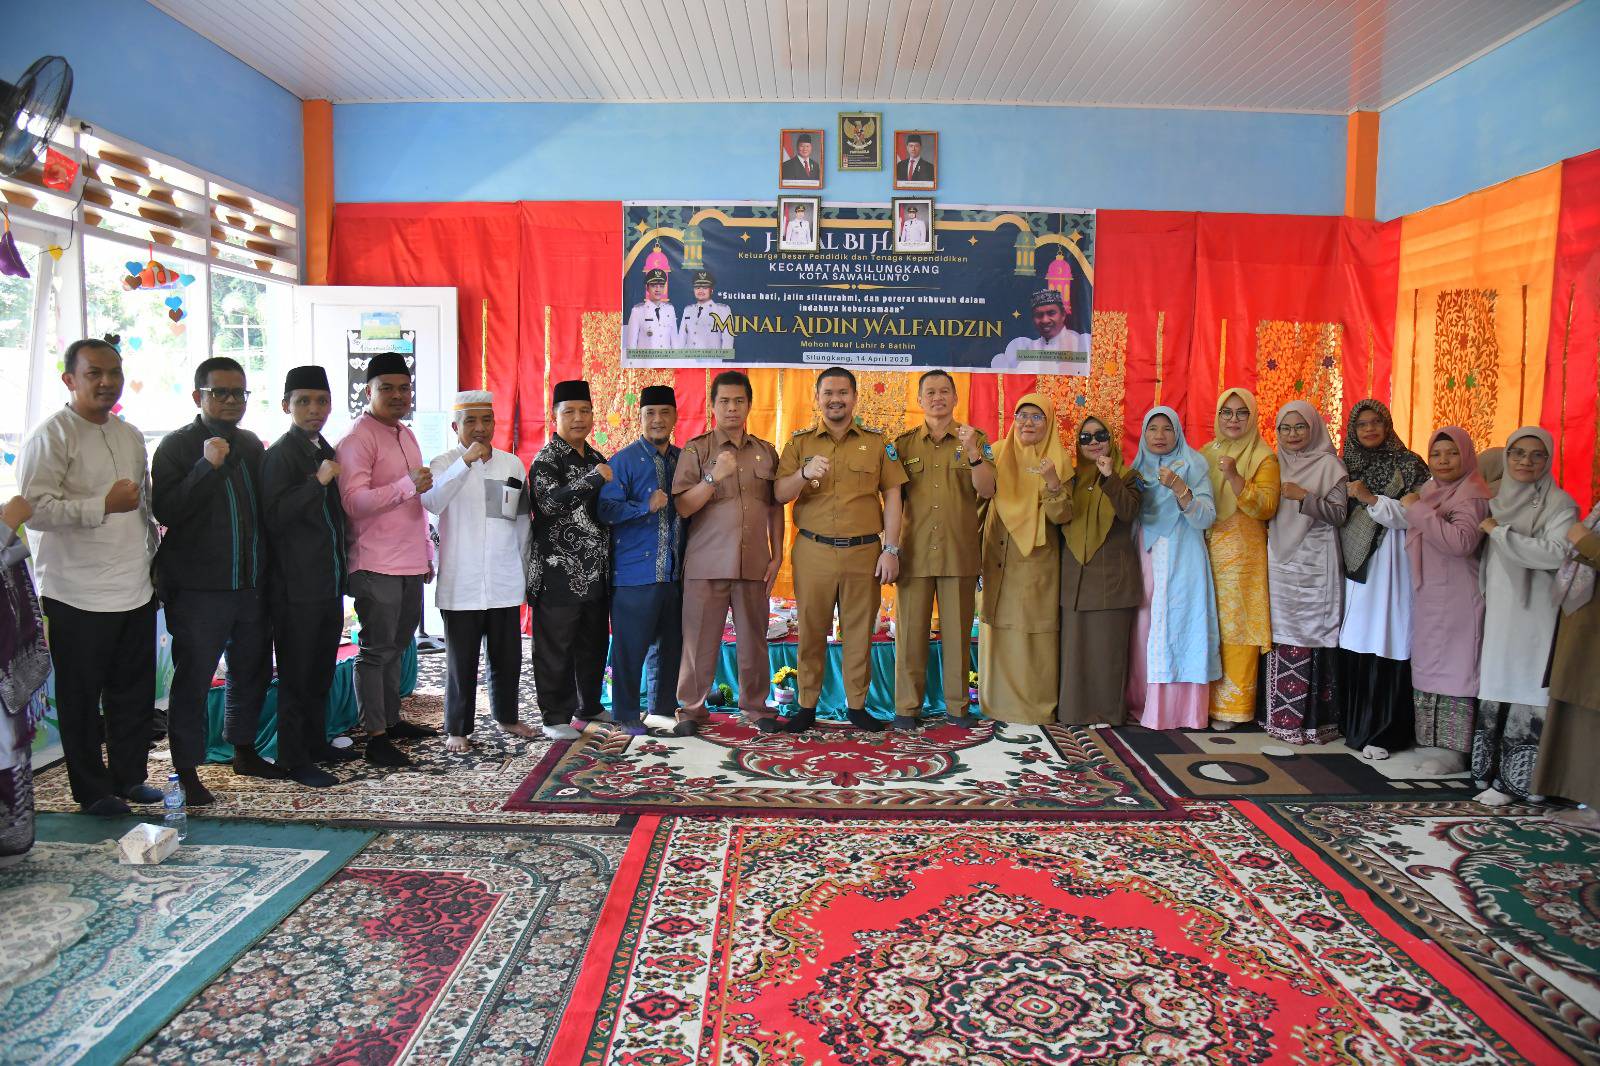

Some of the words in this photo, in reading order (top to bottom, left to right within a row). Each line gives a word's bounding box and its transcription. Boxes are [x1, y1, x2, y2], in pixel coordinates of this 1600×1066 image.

[843, 232, 865, 250] BI
[738, 252, 778, 260] Keluarga
[851, 253, 868, 261] dan
[871, 254, 903, 262] Tenaga
[906, 255, 968, 263] Kependidikan
[769, 262, 850, 273] KECAMATAN
[855, 263, 940, 275] SILUNGKANG
[799, 272, 829, 280] KOTA
[832, 272, 910, 282] SAWAHLUNTO
[759, 292, 781, 302] hati,
[783, 292, 804, 302] jalin
[806, 293, 861, 302] silaturahmi,
[864, 294, 880, 302] dan
[882, 294, 915, 303] pererat
[917, 295, 957, 304] ukhuwah
[959, 295, 986, 304] dalam
[799, 303, 839, 313] indahnya
[709, 312, 788, 337] MINAL
[792, 315, 858, 338] AIDIN
[862, 313, 1003, 339] WALFAIDZIN
[800, 340, 829, 348] Mohon
[832, 341, 853, 349] Maaf
[888, 342, 916, 350] Bathin
[806, 354, 853, 363] Silungkang,
[867, 355, 887, 363] April
